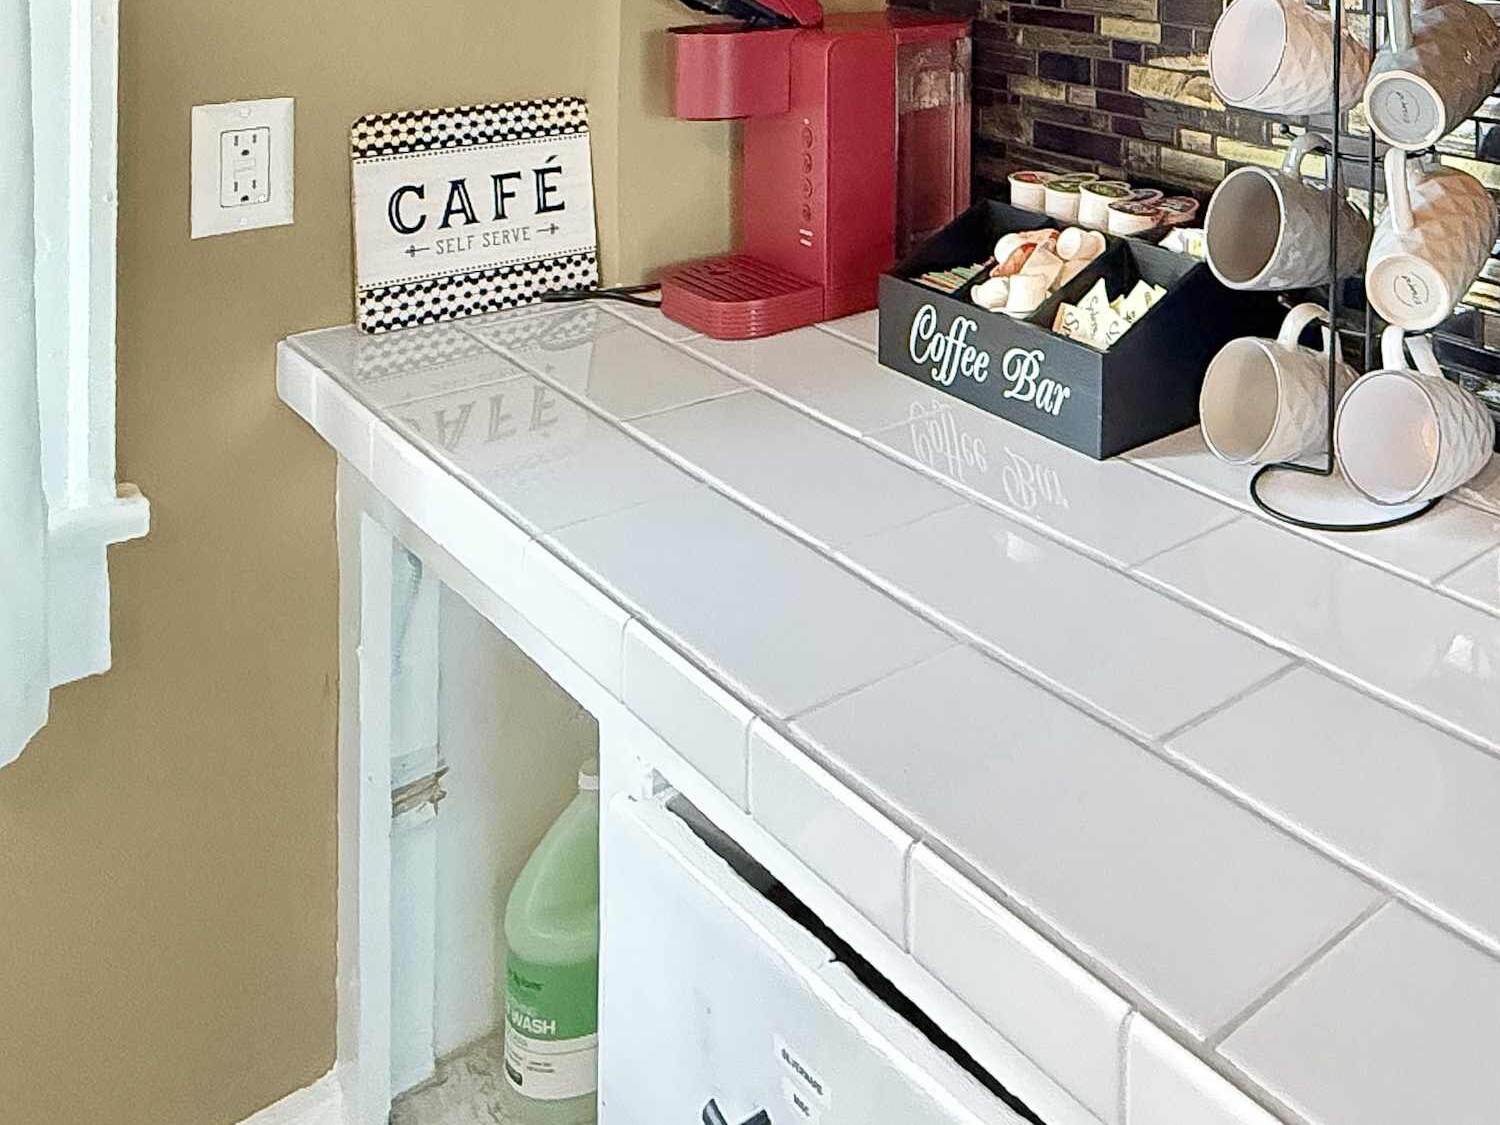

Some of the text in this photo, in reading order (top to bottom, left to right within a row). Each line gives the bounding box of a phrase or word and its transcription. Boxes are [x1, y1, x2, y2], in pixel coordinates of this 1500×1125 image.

[387, 155, 566, 235] CAFÉ
[436, 227, 531, 255] SELF SERVE
[909, 304, 1071, 416] Coffee Bar
[511, 1011, 556, 1036] WASH
